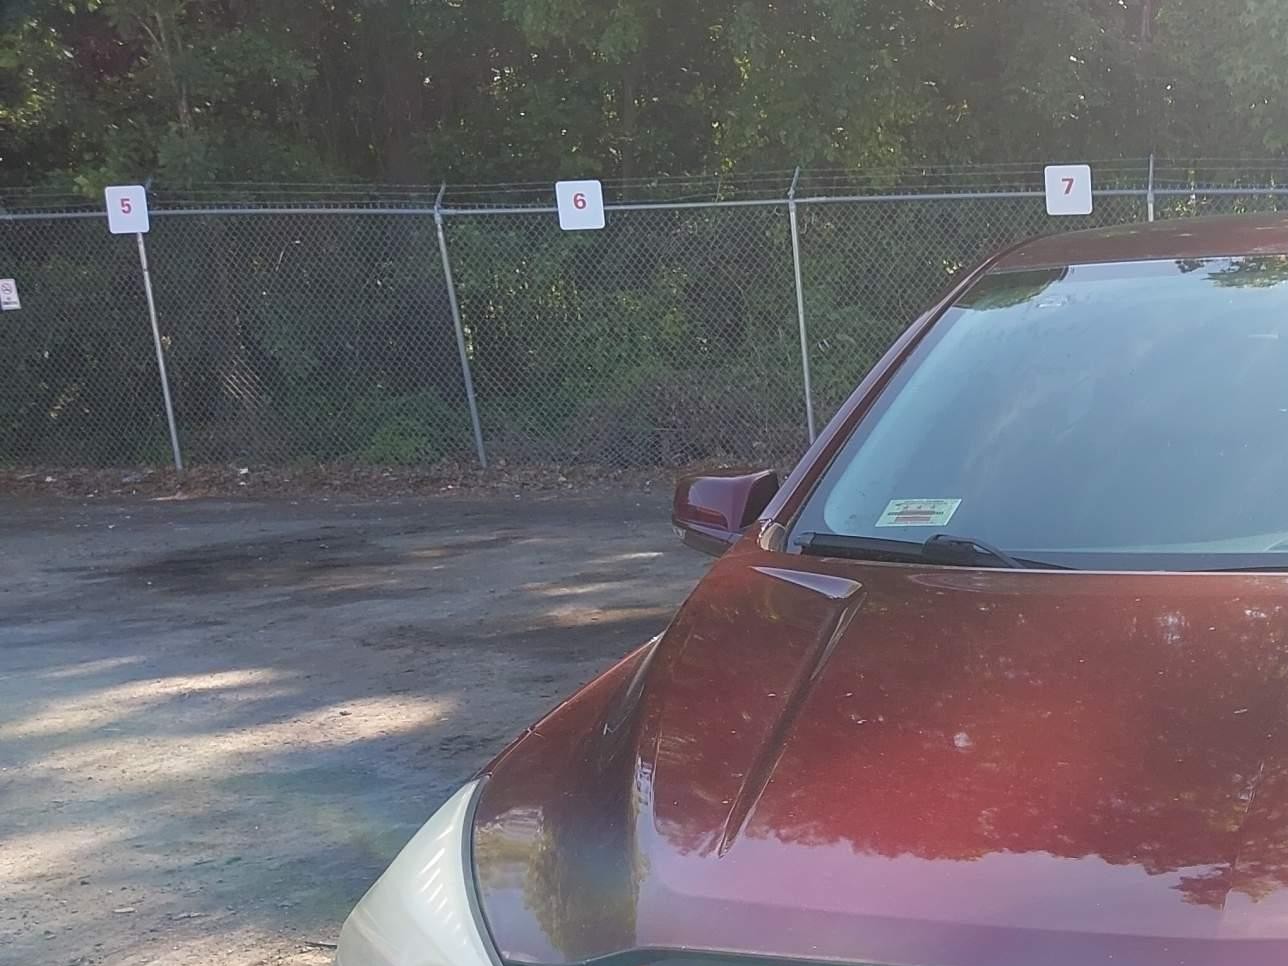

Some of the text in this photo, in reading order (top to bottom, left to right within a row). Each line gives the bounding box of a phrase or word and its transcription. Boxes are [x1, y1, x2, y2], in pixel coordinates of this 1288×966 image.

[1061, 177, 1075, 195] 7
[119, 197, 132, 215] 5
[573, 192, 587, 210] 6
